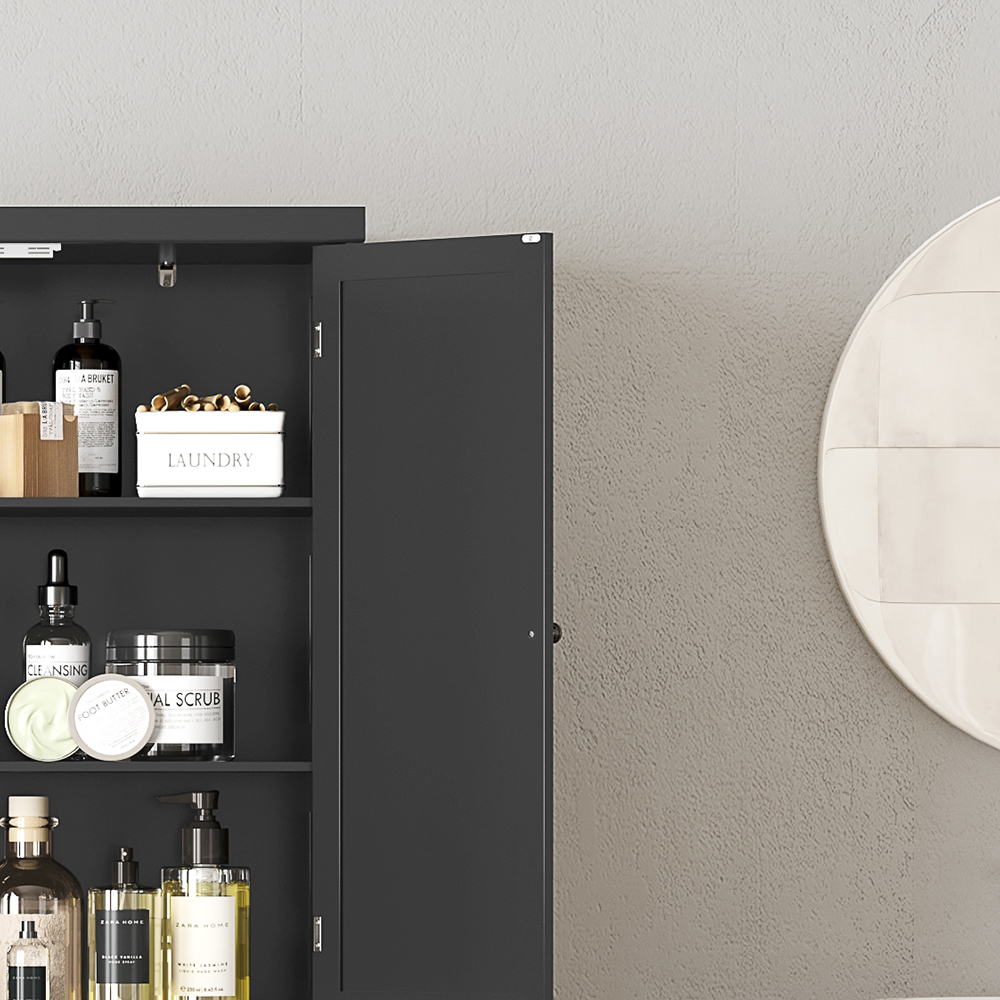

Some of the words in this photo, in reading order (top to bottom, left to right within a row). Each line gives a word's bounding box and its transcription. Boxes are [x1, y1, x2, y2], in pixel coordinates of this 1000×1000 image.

[87, 374, 115, 384] BRUKET
[168, 452, 253, 468] LAUNDRY
[27, 664, 88, 676] CLEANSING
[77, 703, 101, 721] FOOT
[101, 687, 131, 708] BUTTER
[176, 692, 221, 707] SCRUB
